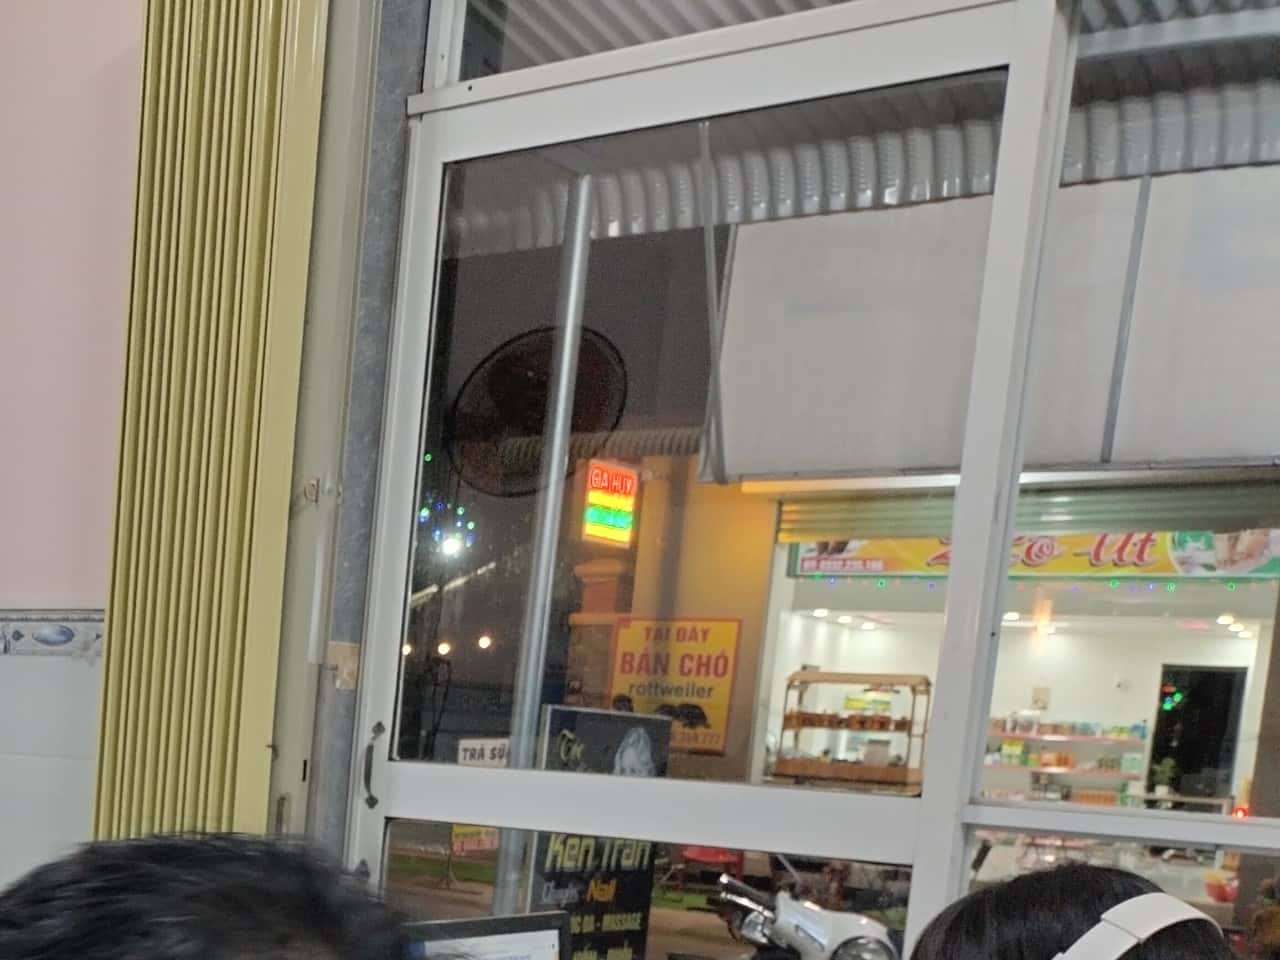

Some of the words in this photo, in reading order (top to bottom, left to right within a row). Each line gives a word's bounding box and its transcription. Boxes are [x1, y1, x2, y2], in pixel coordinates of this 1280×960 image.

[621, 649, 670, 676] BÁN
[679, 650, 729, 678] CHÓ
[628, 682, 716, 698] rottweiler
[462, 746, 486, 760] TRÀ
[488, 744, 507, 760] SỮ
